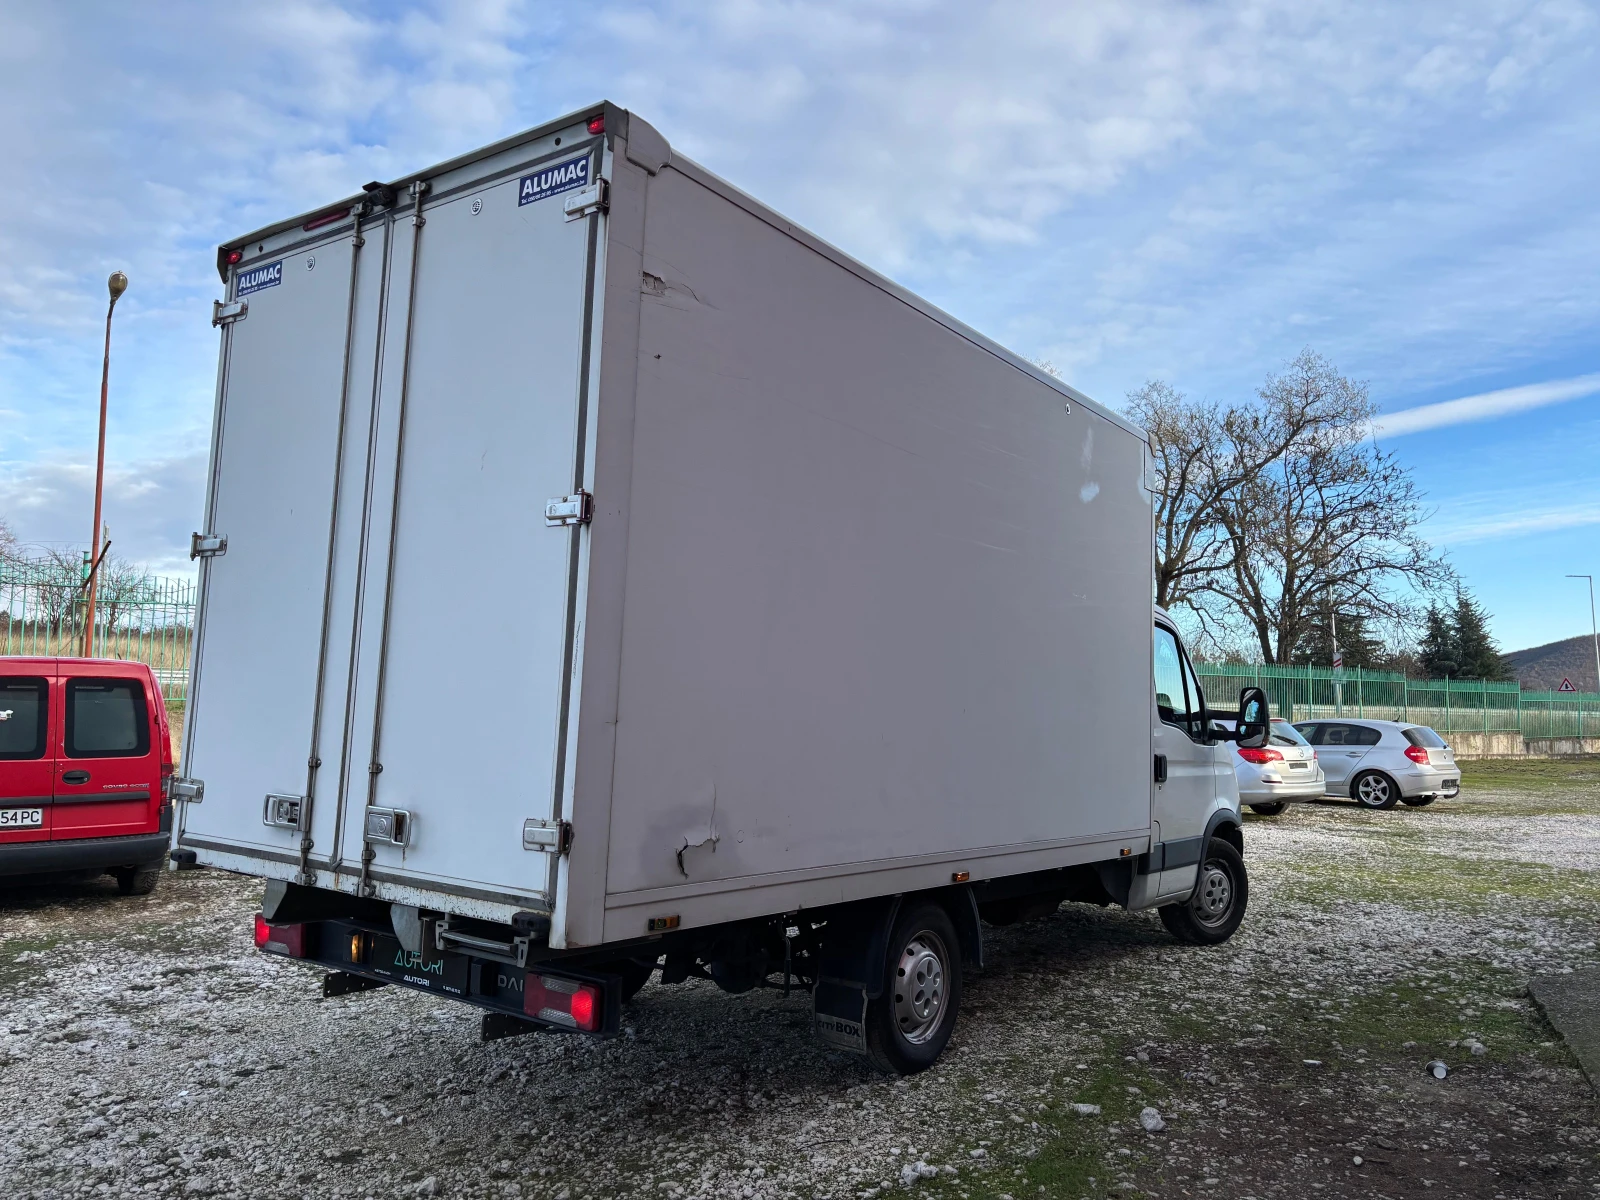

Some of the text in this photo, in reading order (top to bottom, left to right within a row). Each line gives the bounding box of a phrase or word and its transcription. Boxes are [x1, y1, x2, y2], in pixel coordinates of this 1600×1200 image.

[521, 159, 587, 197] ALUMAC
[238, 264, 281, 290] ALUMAC
[403, 974, 430, 987] AUTORI
